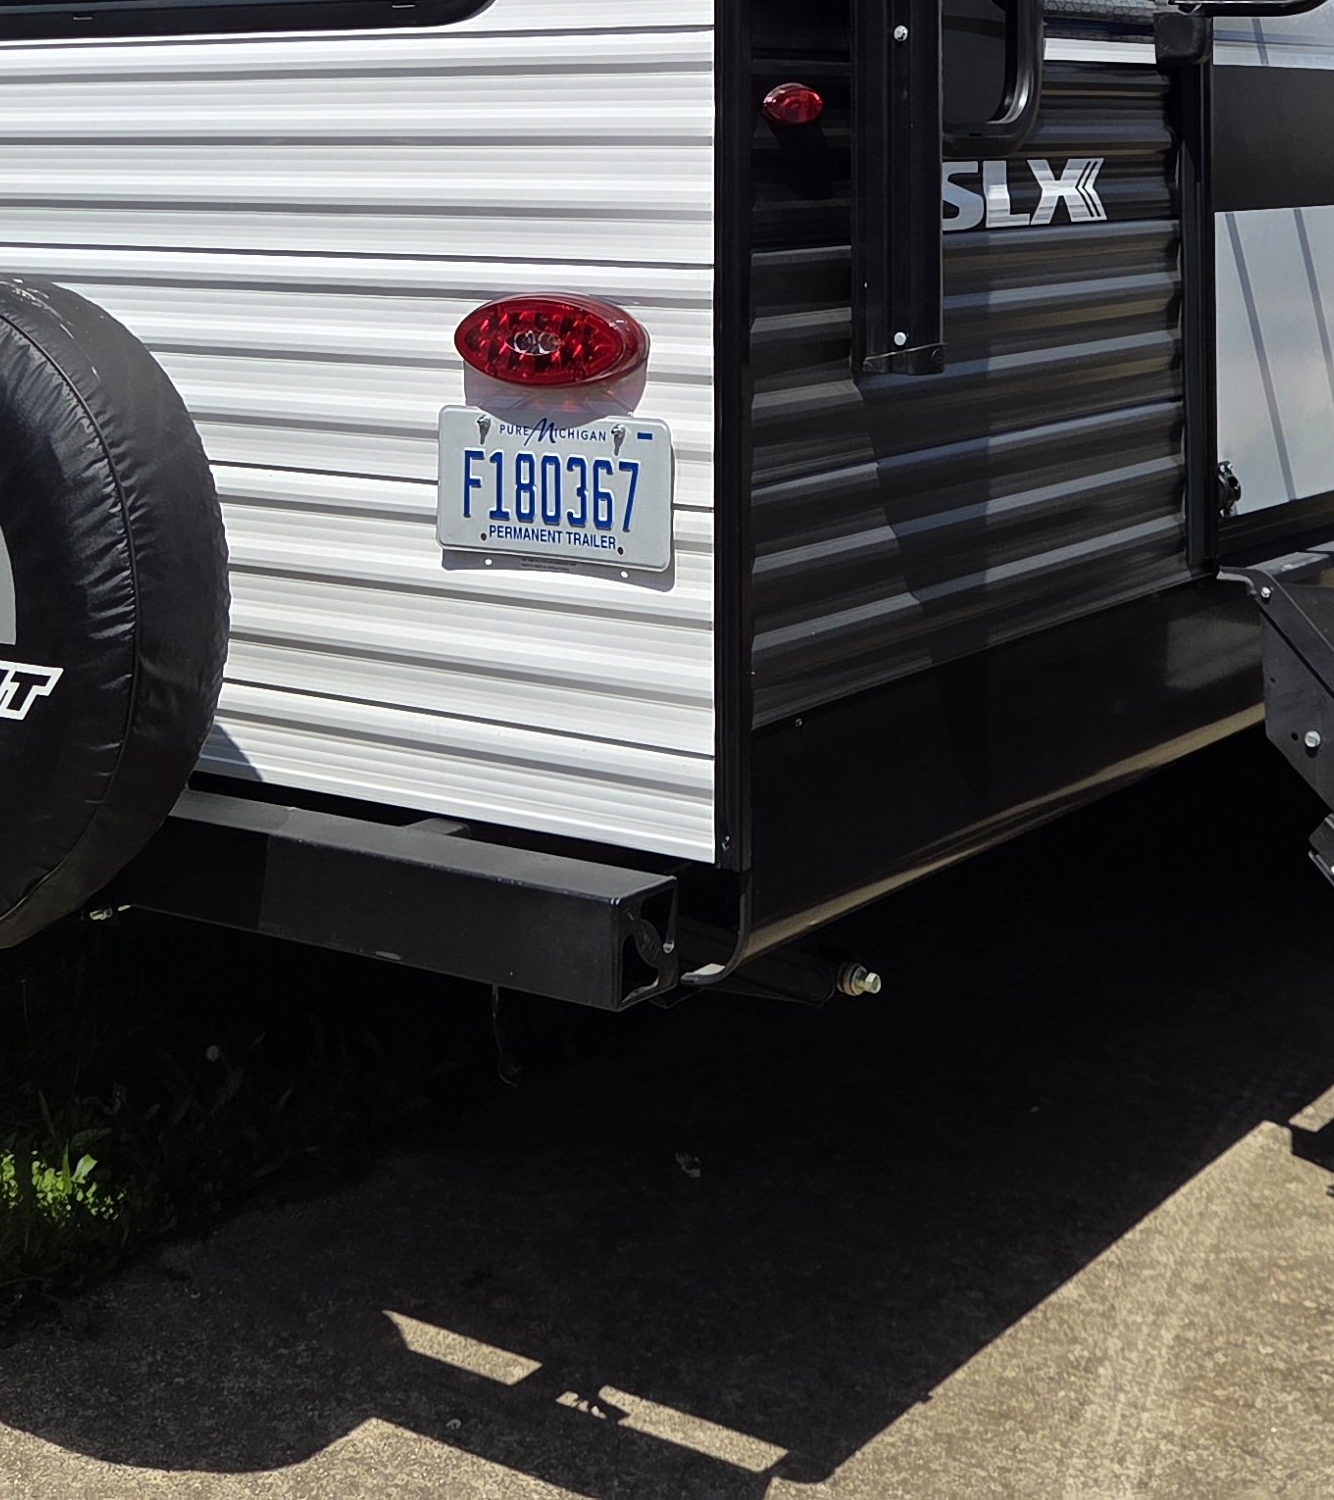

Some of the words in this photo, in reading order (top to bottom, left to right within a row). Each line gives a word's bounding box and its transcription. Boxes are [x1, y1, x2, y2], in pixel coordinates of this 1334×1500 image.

[942, 157, 1108, 231] SLX
[499, 424, 531, 435] PURE
[524, 417, 607, 446] MICHIGAN
[463, 449, 640, 532] F180367
[488, 524, 563, 545] PERMANENT
[566, 532, 616, 549] TRAILER
